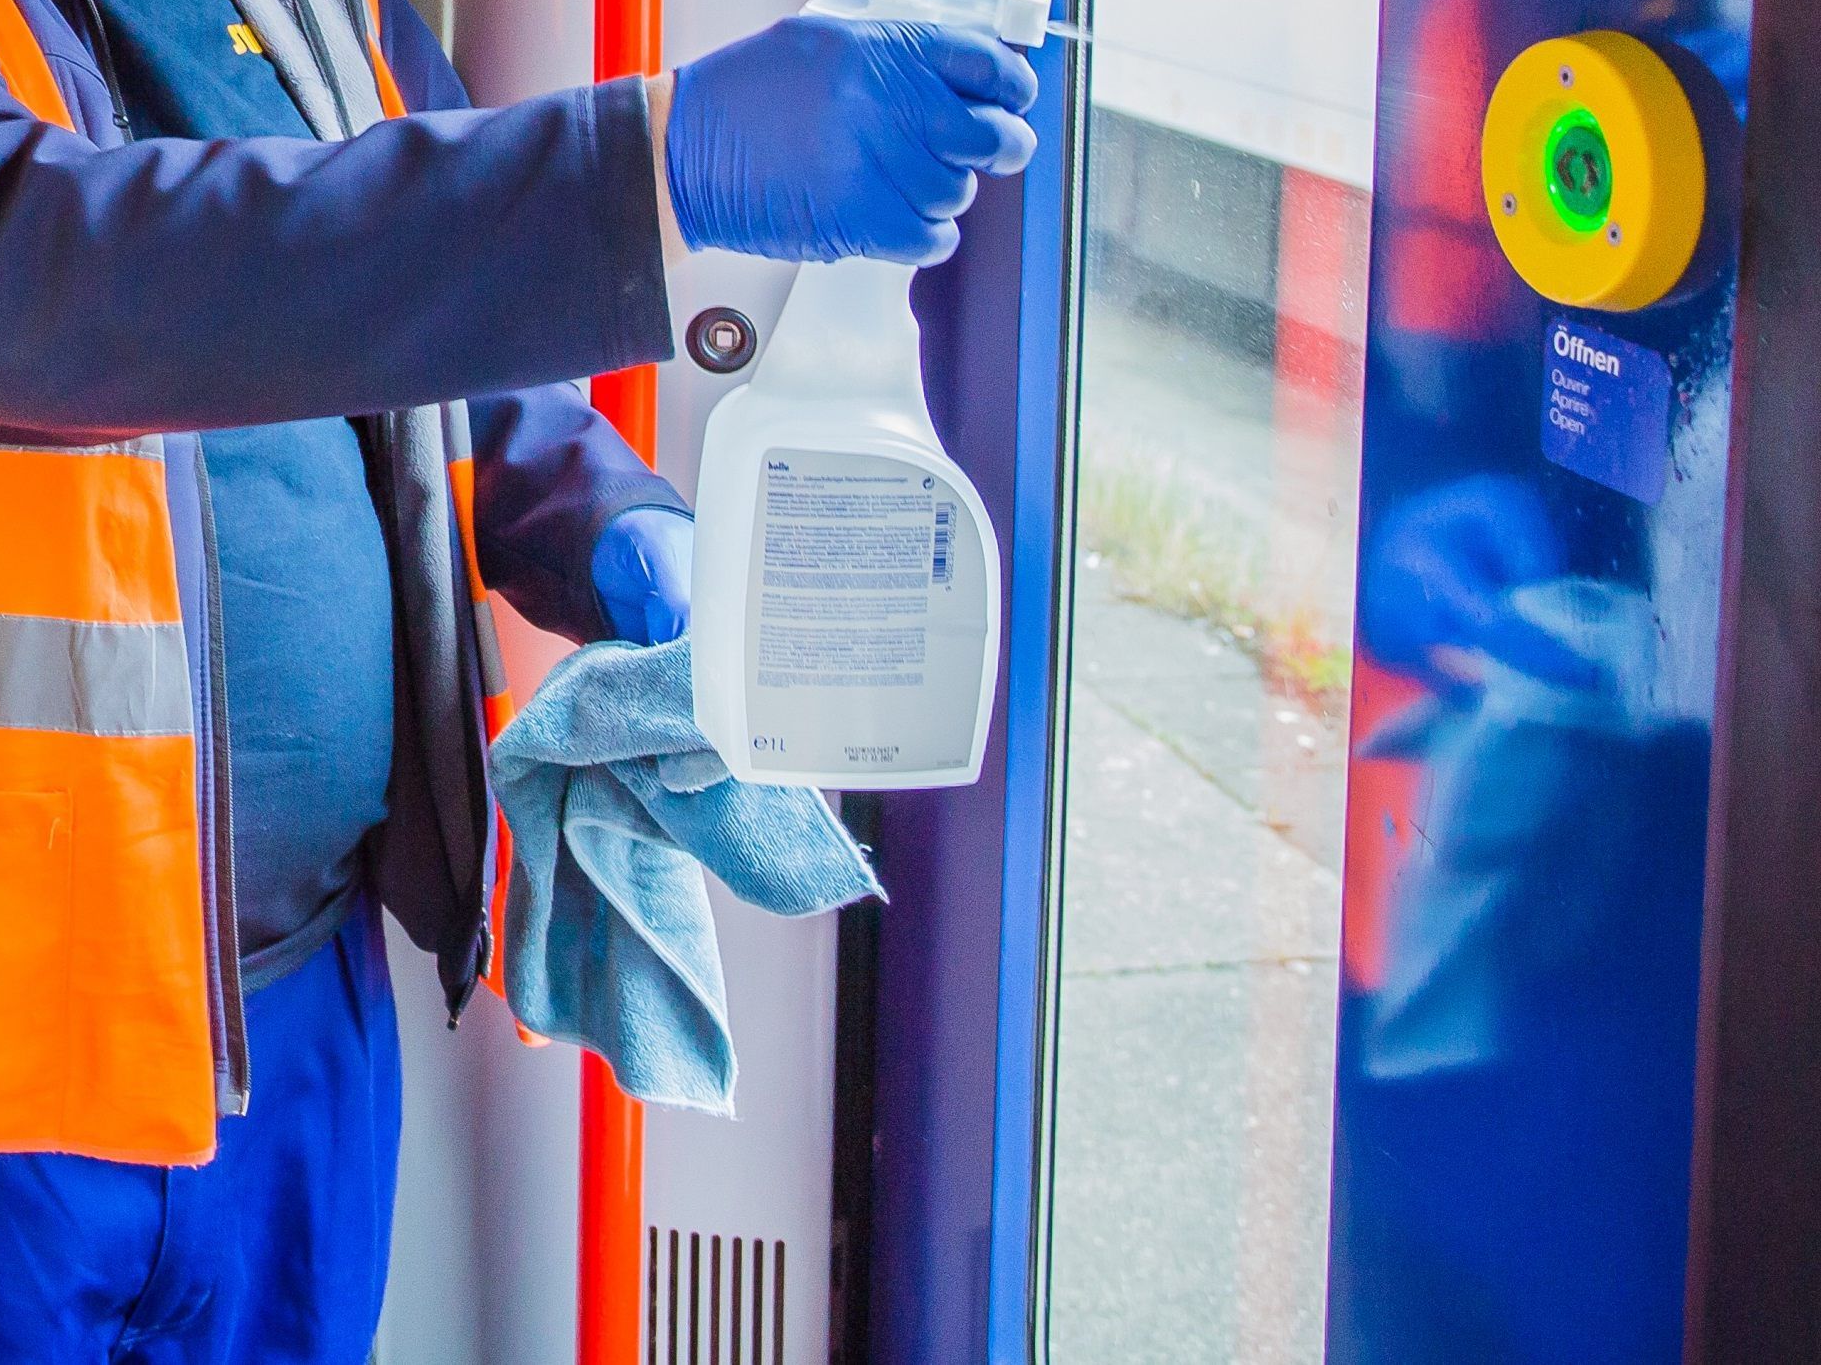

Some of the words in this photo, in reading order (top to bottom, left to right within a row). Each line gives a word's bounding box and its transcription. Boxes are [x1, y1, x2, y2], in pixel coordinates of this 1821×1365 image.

[1553, 324, 1620, 378] Öffnen
[1551, 368, 1591, 396] Ouvrir
[1548, 406, 1585, 436] Open
